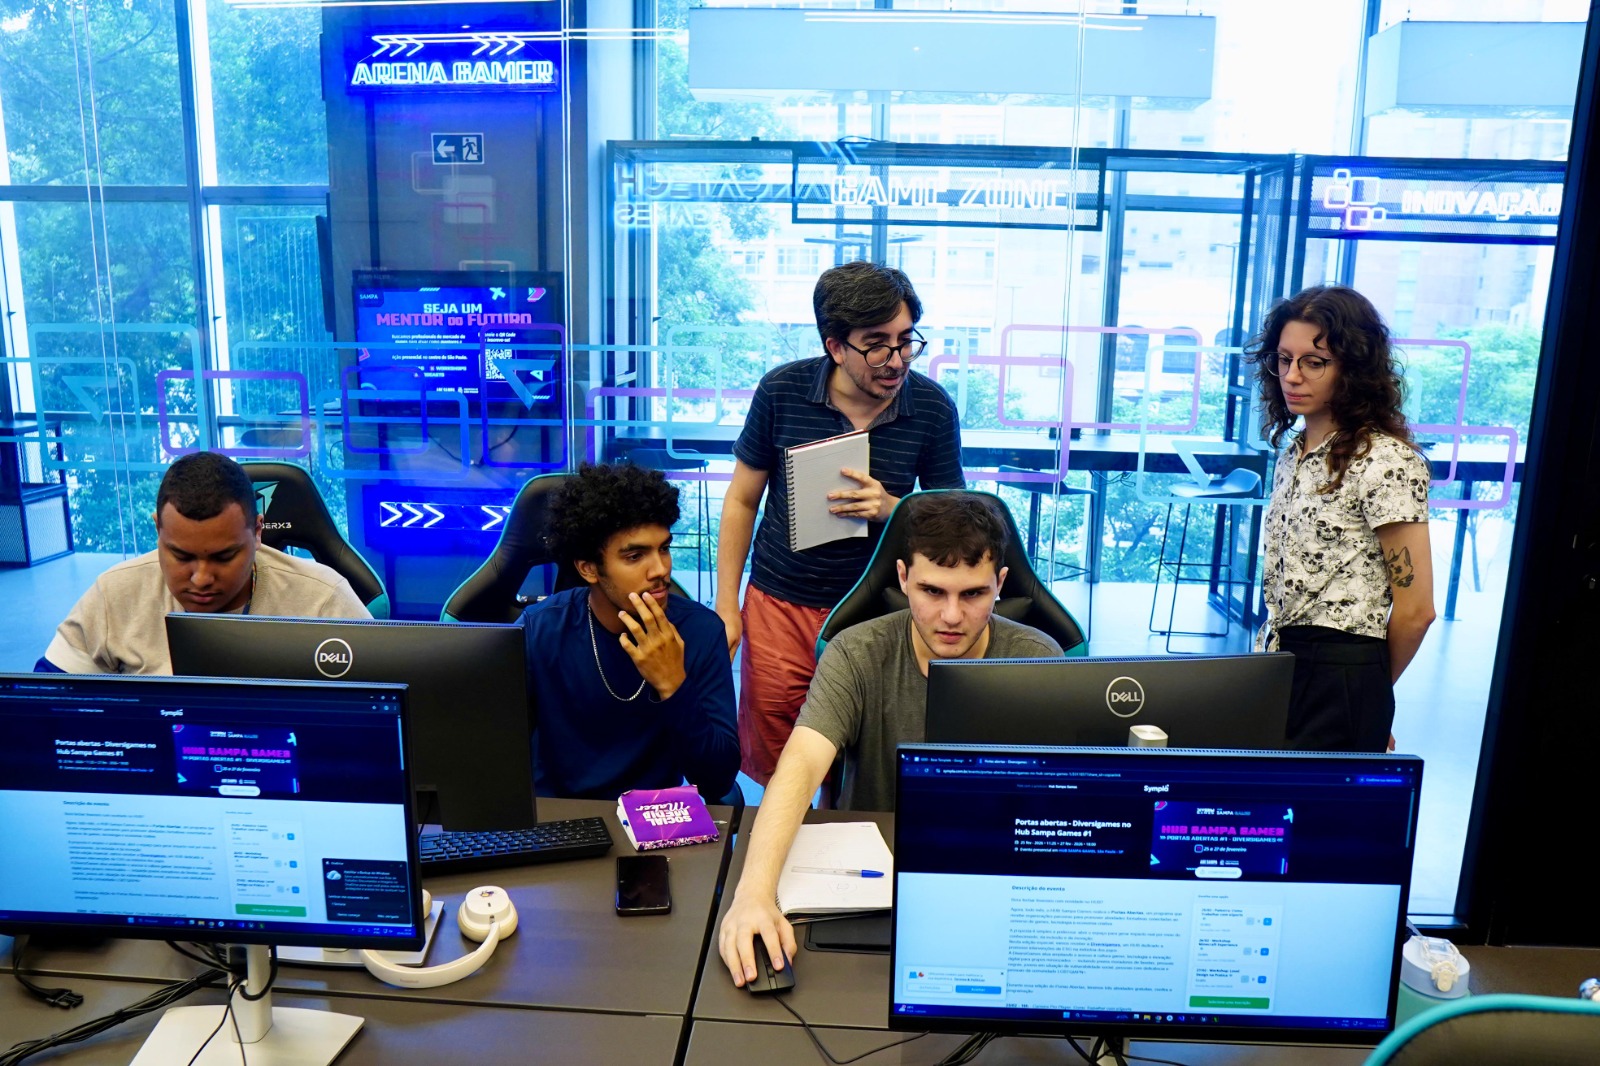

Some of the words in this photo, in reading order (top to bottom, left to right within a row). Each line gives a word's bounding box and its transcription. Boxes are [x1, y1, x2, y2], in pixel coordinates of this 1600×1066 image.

[351, 61, 447, 85] ARENA
[451, 60, 554, 85] GAMER
[830, 175, 949, 207] GAME
[958, 178, 1069, 210] ZONE
[423, 303, 458, 314] SEJA
[461, 303, 483, 314] UM
[376, 313, 444, 326] MENTOR
[319, 652, 348, 664] DELL
[1110, 691, 1141, 703] DELL
[635, 801, 691, 812] Maker
[645, 815, 693, 827] SOCIAL
[1015, 818, 1039, 826] Portas
[1040, 819, 1068, 827] abertas
[1072, 820, 1121, 829] Diversigames
[1031, 829, 1056, 838] Sampa
[1161, 825, 1188, 834] HUB
[1191, 825, 1237, 835] SAMPA
